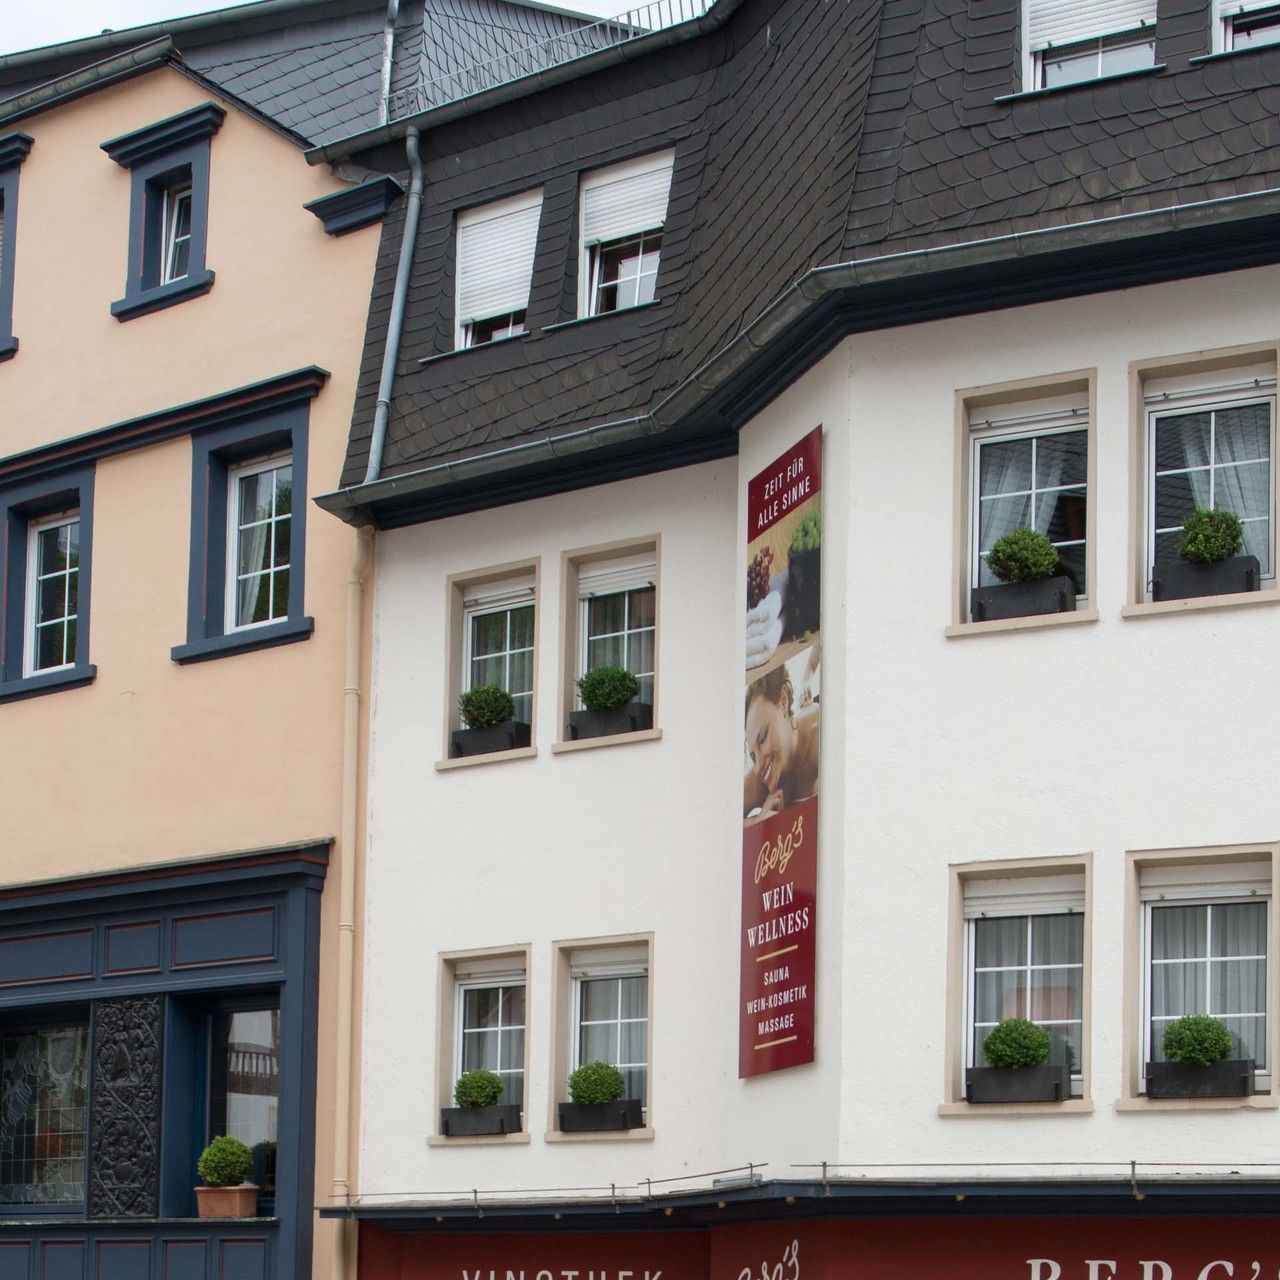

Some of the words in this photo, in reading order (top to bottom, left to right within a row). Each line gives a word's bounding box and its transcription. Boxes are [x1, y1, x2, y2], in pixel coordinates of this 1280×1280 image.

[764, 472, 784, 500] ZEIT
[787, 456, 804, 483] FÜR
[757, 500, 779, 529] ALLE
[782, 475, 810, 510] SINNE
[754, 815, 804, 885] Berg's
[762, 881, 795, 914] WEIN
[747, 907, 810, 949] WELLNESS
[763, 965, 790, 986] SAUNA
[746, 984, 807, 1015] WEIN-KOSMETIK
[757, 1013, 795, 1036] MASSAGE
